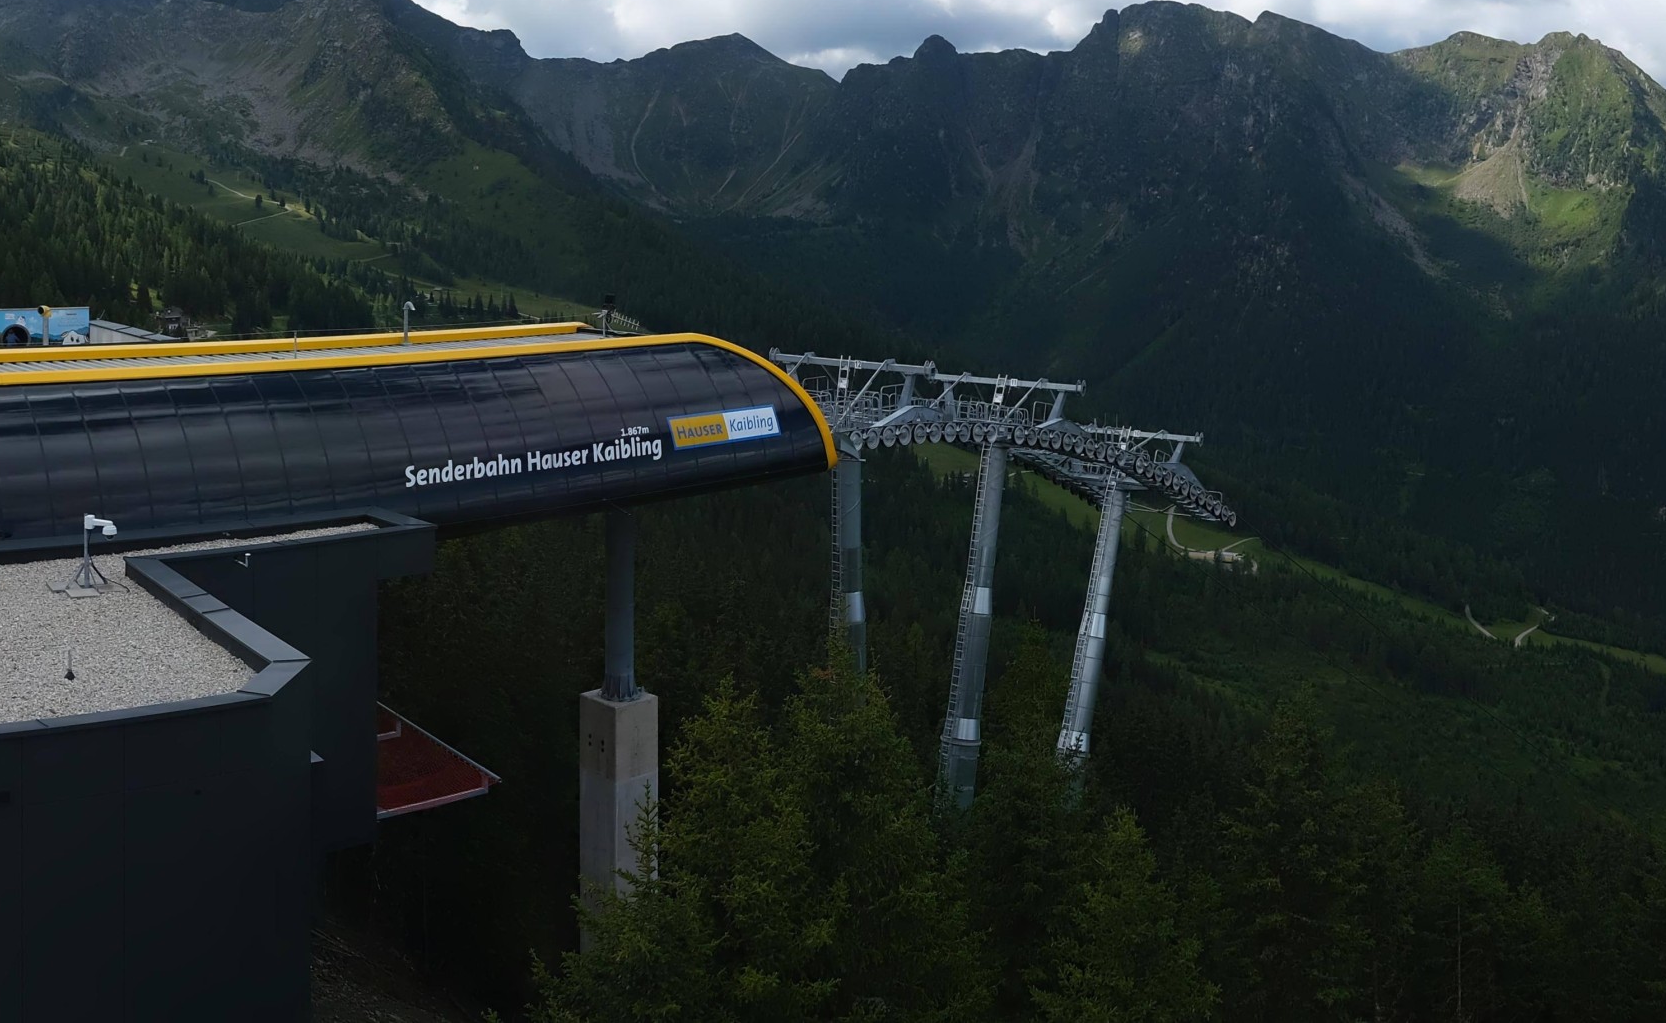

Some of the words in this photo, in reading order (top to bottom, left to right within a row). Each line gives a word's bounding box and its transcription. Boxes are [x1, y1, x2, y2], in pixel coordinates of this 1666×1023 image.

[620, 426, 650, 437] 1.867m
[676, 422, 723, 440] HAUSER
[728, 413, 774, 432] Kaibling
[405, 453, 522, 488] Senderbahn
[527, 447, 589, 473] Hauser
[592, 437, 663, 463] Kaibling
